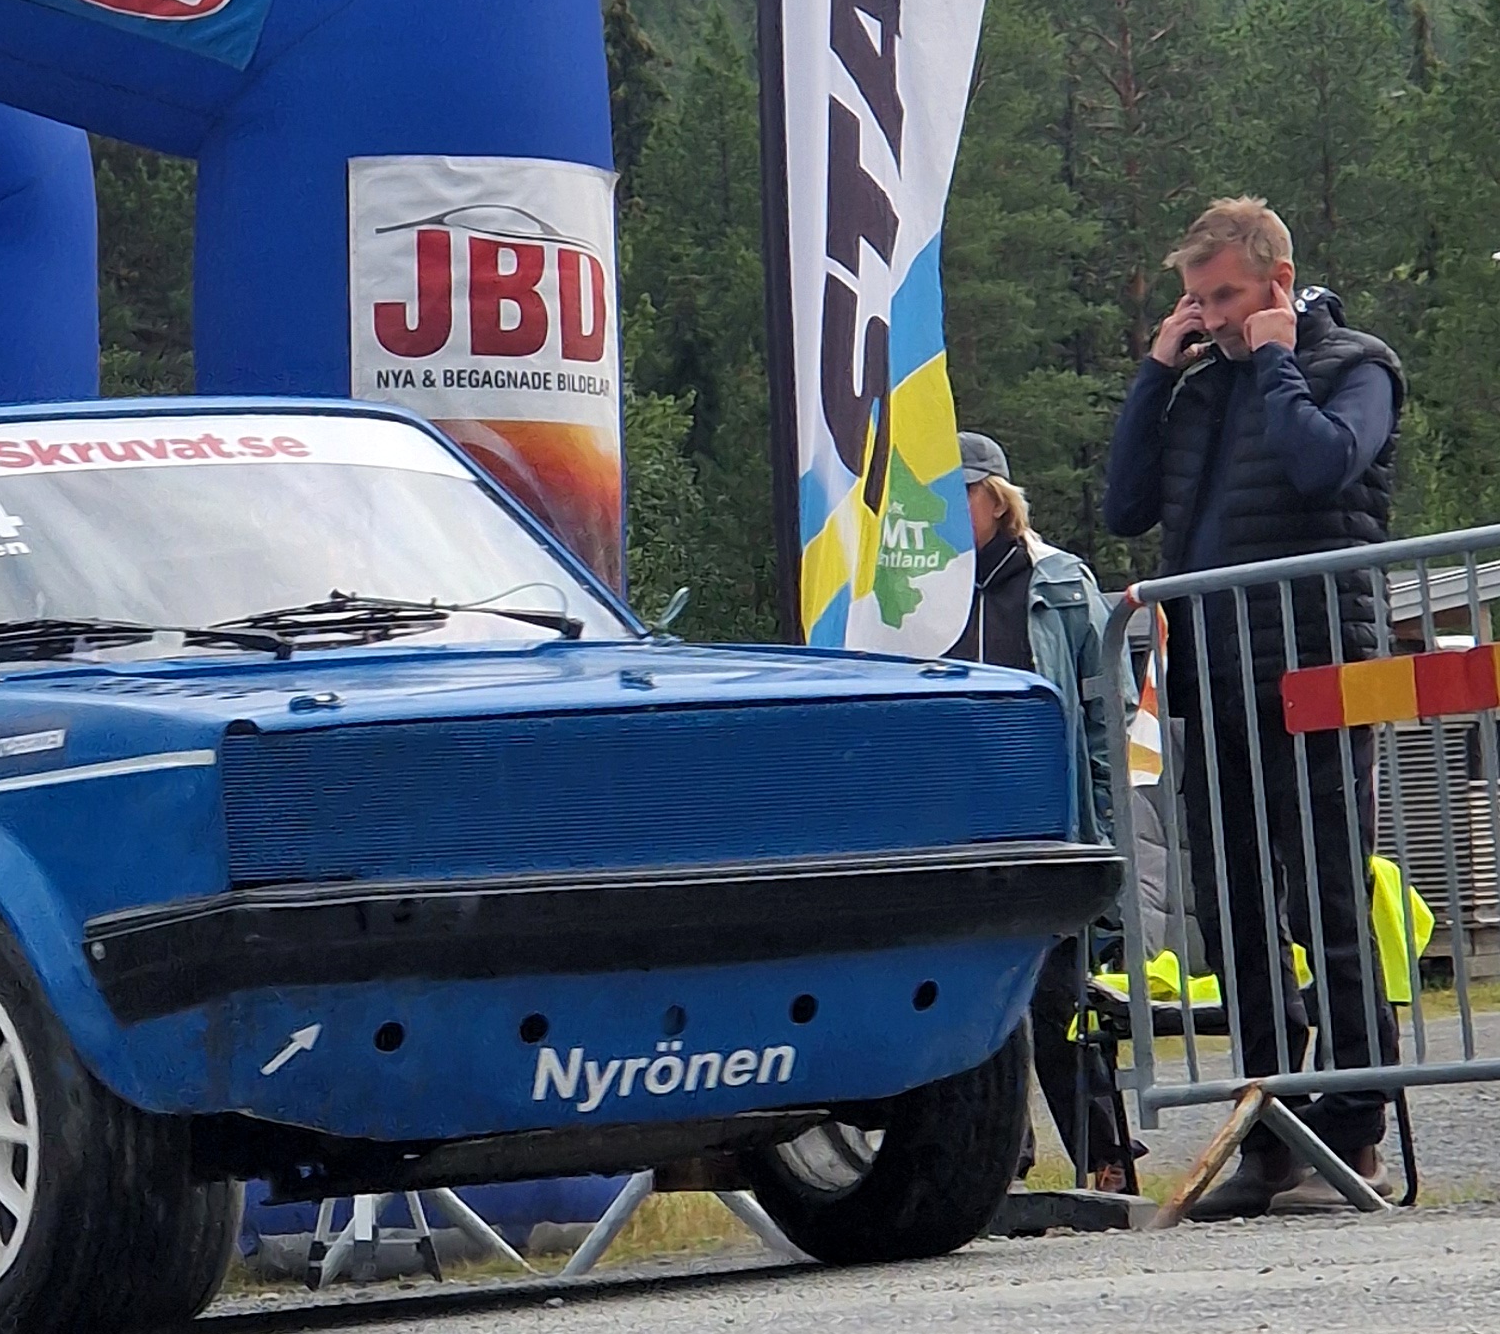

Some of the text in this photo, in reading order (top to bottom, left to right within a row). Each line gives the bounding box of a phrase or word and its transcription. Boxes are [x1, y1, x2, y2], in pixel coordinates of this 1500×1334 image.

[374, 229, 607, 363] JBD
[376, 369, 416, 389] NYA
[421, 369, 437, 389] &
[443, 369, 552, 391] BEGAGNADE
[531, 1039, 797, 1114] Nyrönen
